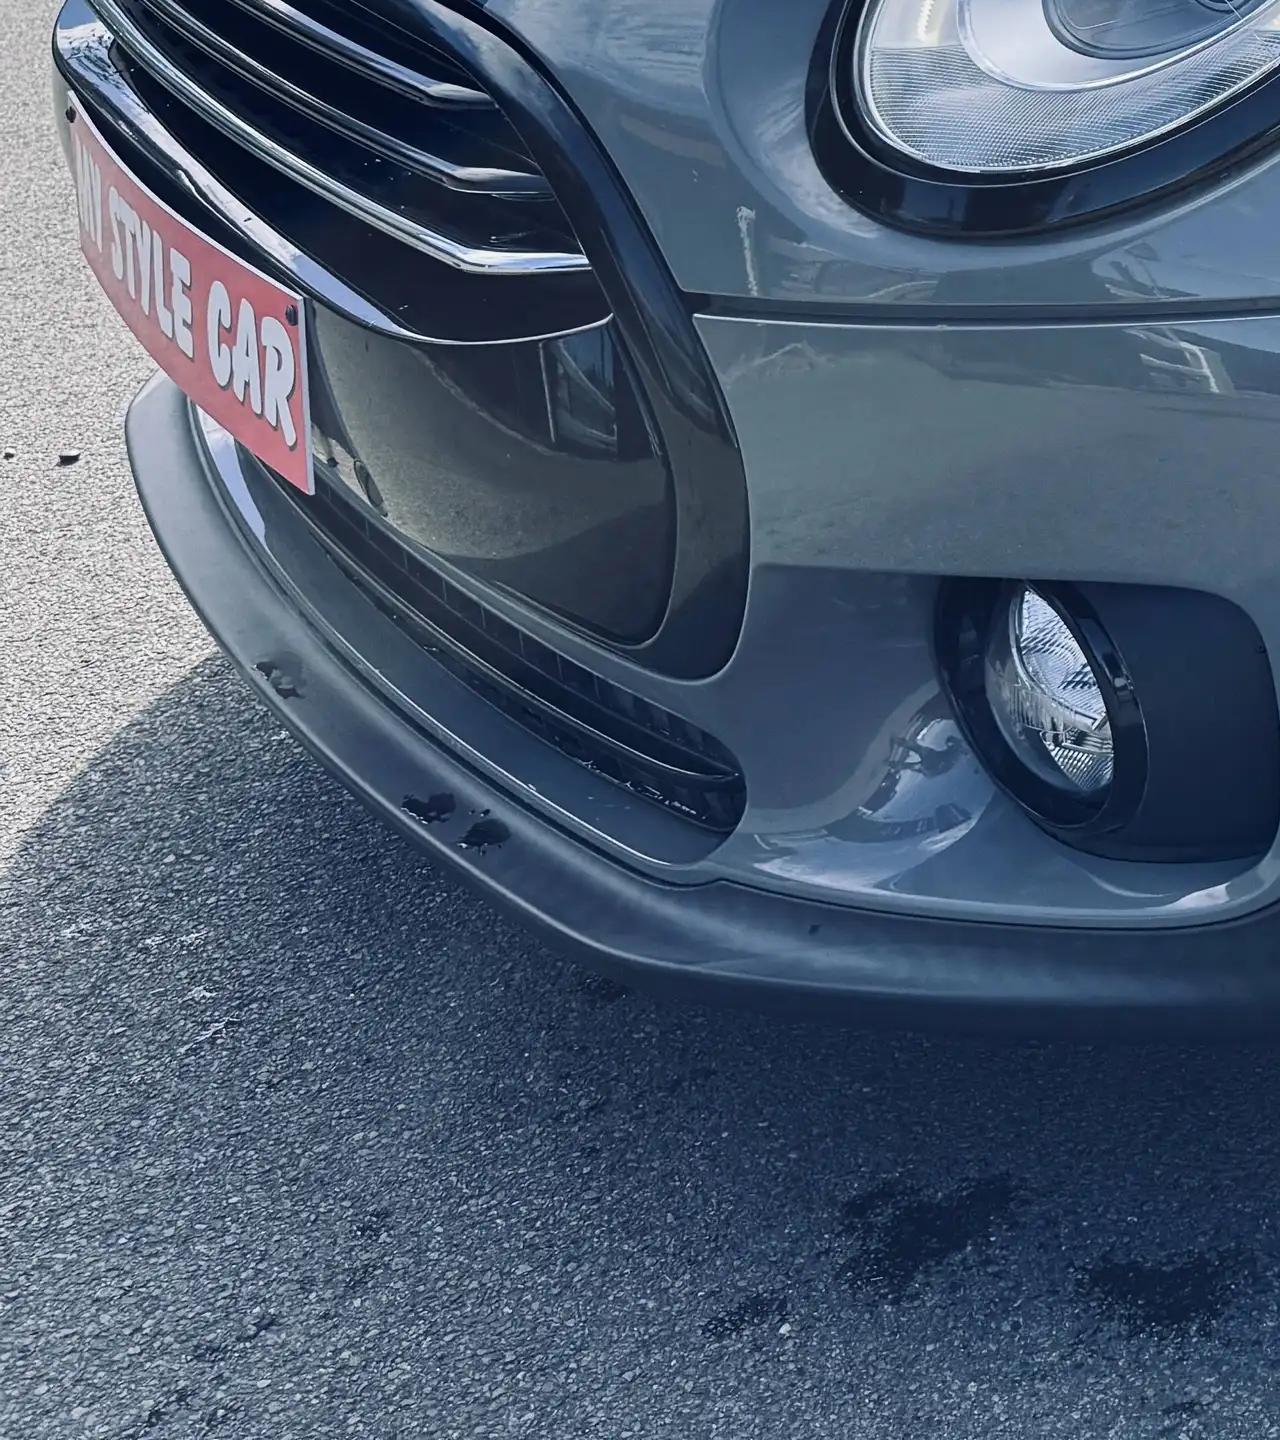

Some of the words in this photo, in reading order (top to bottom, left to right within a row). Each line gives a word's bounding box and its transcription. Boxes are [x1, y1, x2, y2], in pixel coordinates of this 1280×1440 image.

[75, 131, 103, 254] MY
[108, 185, 195, 360] STYLE
[206, 279, 298, 449] CAR
